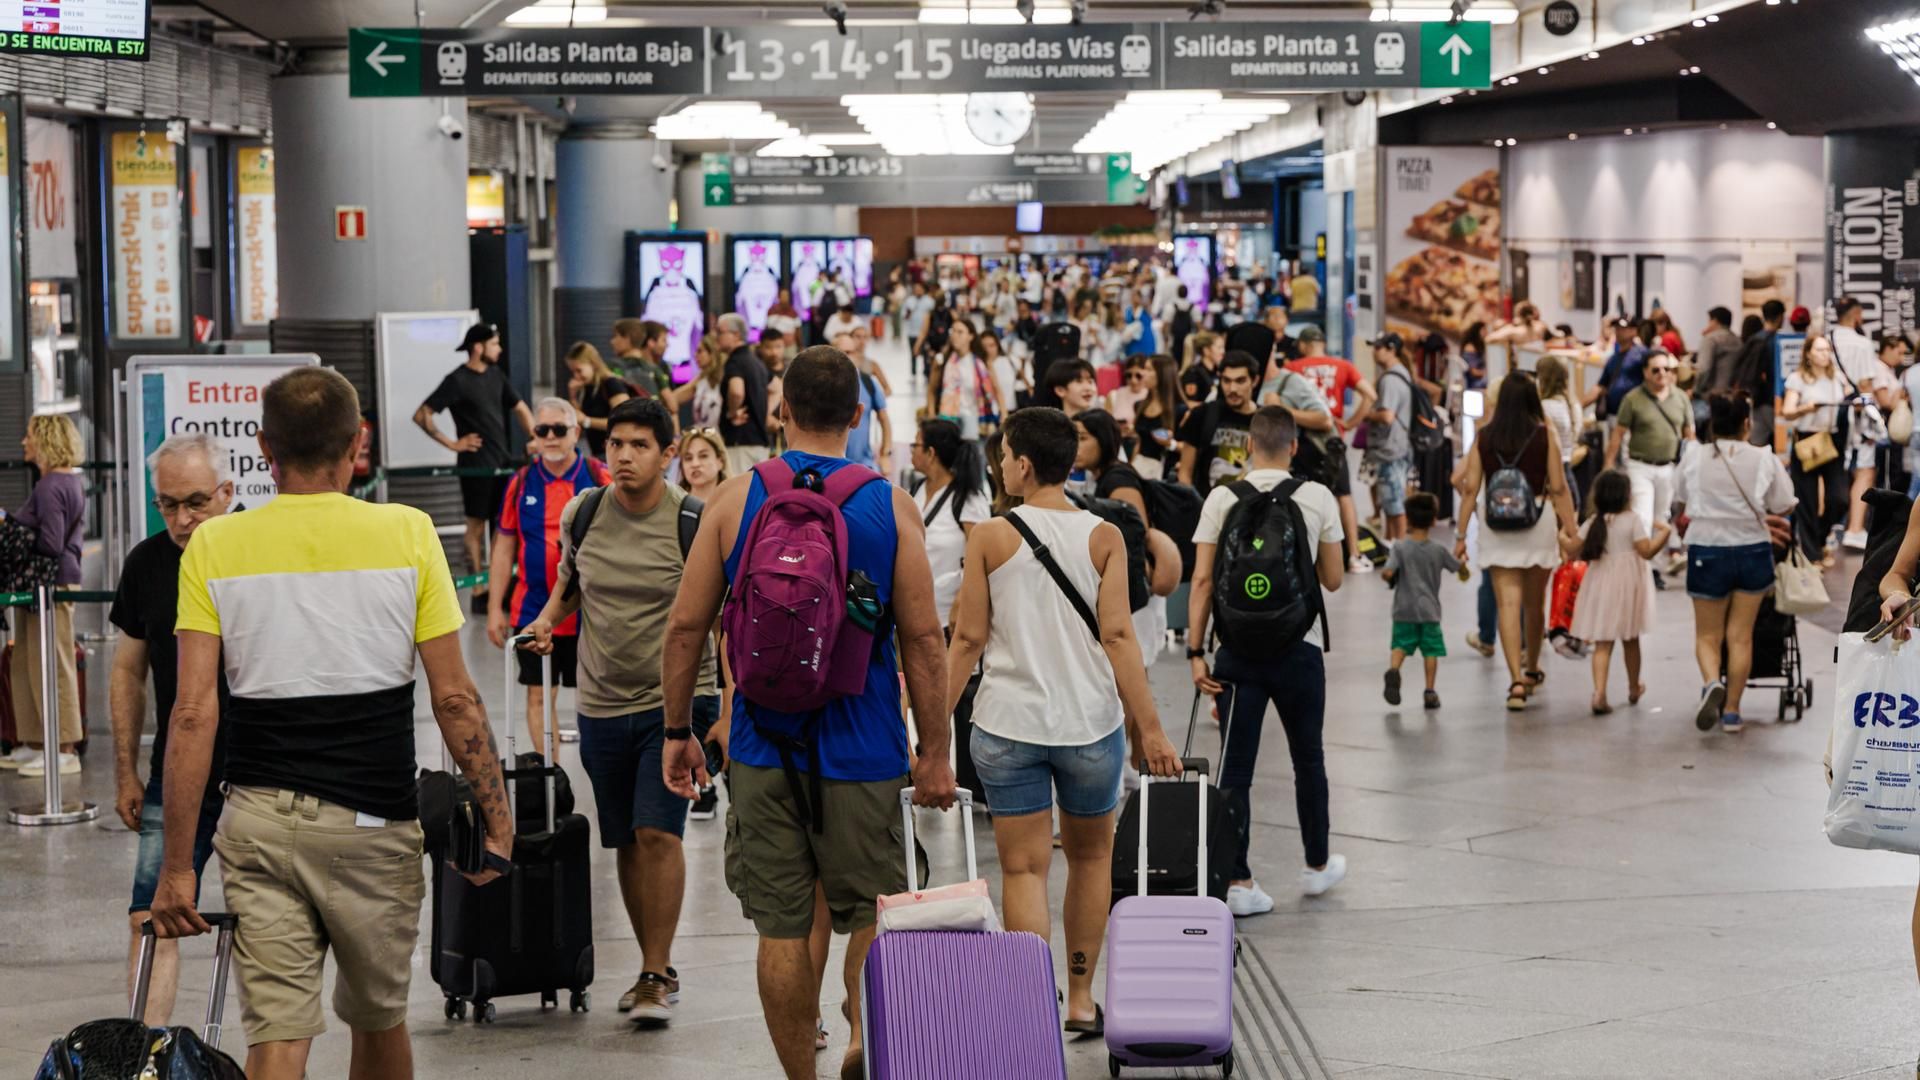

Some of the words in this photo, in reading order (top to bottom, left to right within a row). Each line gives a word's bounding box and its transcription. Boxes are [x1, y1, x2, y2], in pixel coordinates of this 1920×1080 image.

[11, 34, 29, 48] SE
[32, 35, 113, 53] ENCUENTRA
[961, 37, 1062, 64] Llegadas
[1067, 35, 1115, 60] Vías
[1174, 34, 1257, 57] Salidas
[1264, 34, 1338, 56] Planta
[1345, 34, 1360, 56] 1
[483, 41, 561, 63] Salidas
[568, 42, 637, 63] Planta
[645, 41, 693, 67] Baja
[483, 72, 558, 85] DEPARTURES
[560, 72, 612, 85] GROUND
[615, 72, 653, 85] FLOOR
[986, 64, 1043, 78] ARRIVALS
[1046, 64, 1116, 78] PLATFORMS
[1230, 62, 1306, 76] DEPARTURES
[1309, 62, 1348, 75] FLOOR
[1350, 62, 1360, 75] 1
[116, 158, 175, 171] tiendas
[1397, 157, 1432, 174] PIZZA
[1882, 188, 1903, 259] QUALITY
[188, 381, 265, 403] Entra
